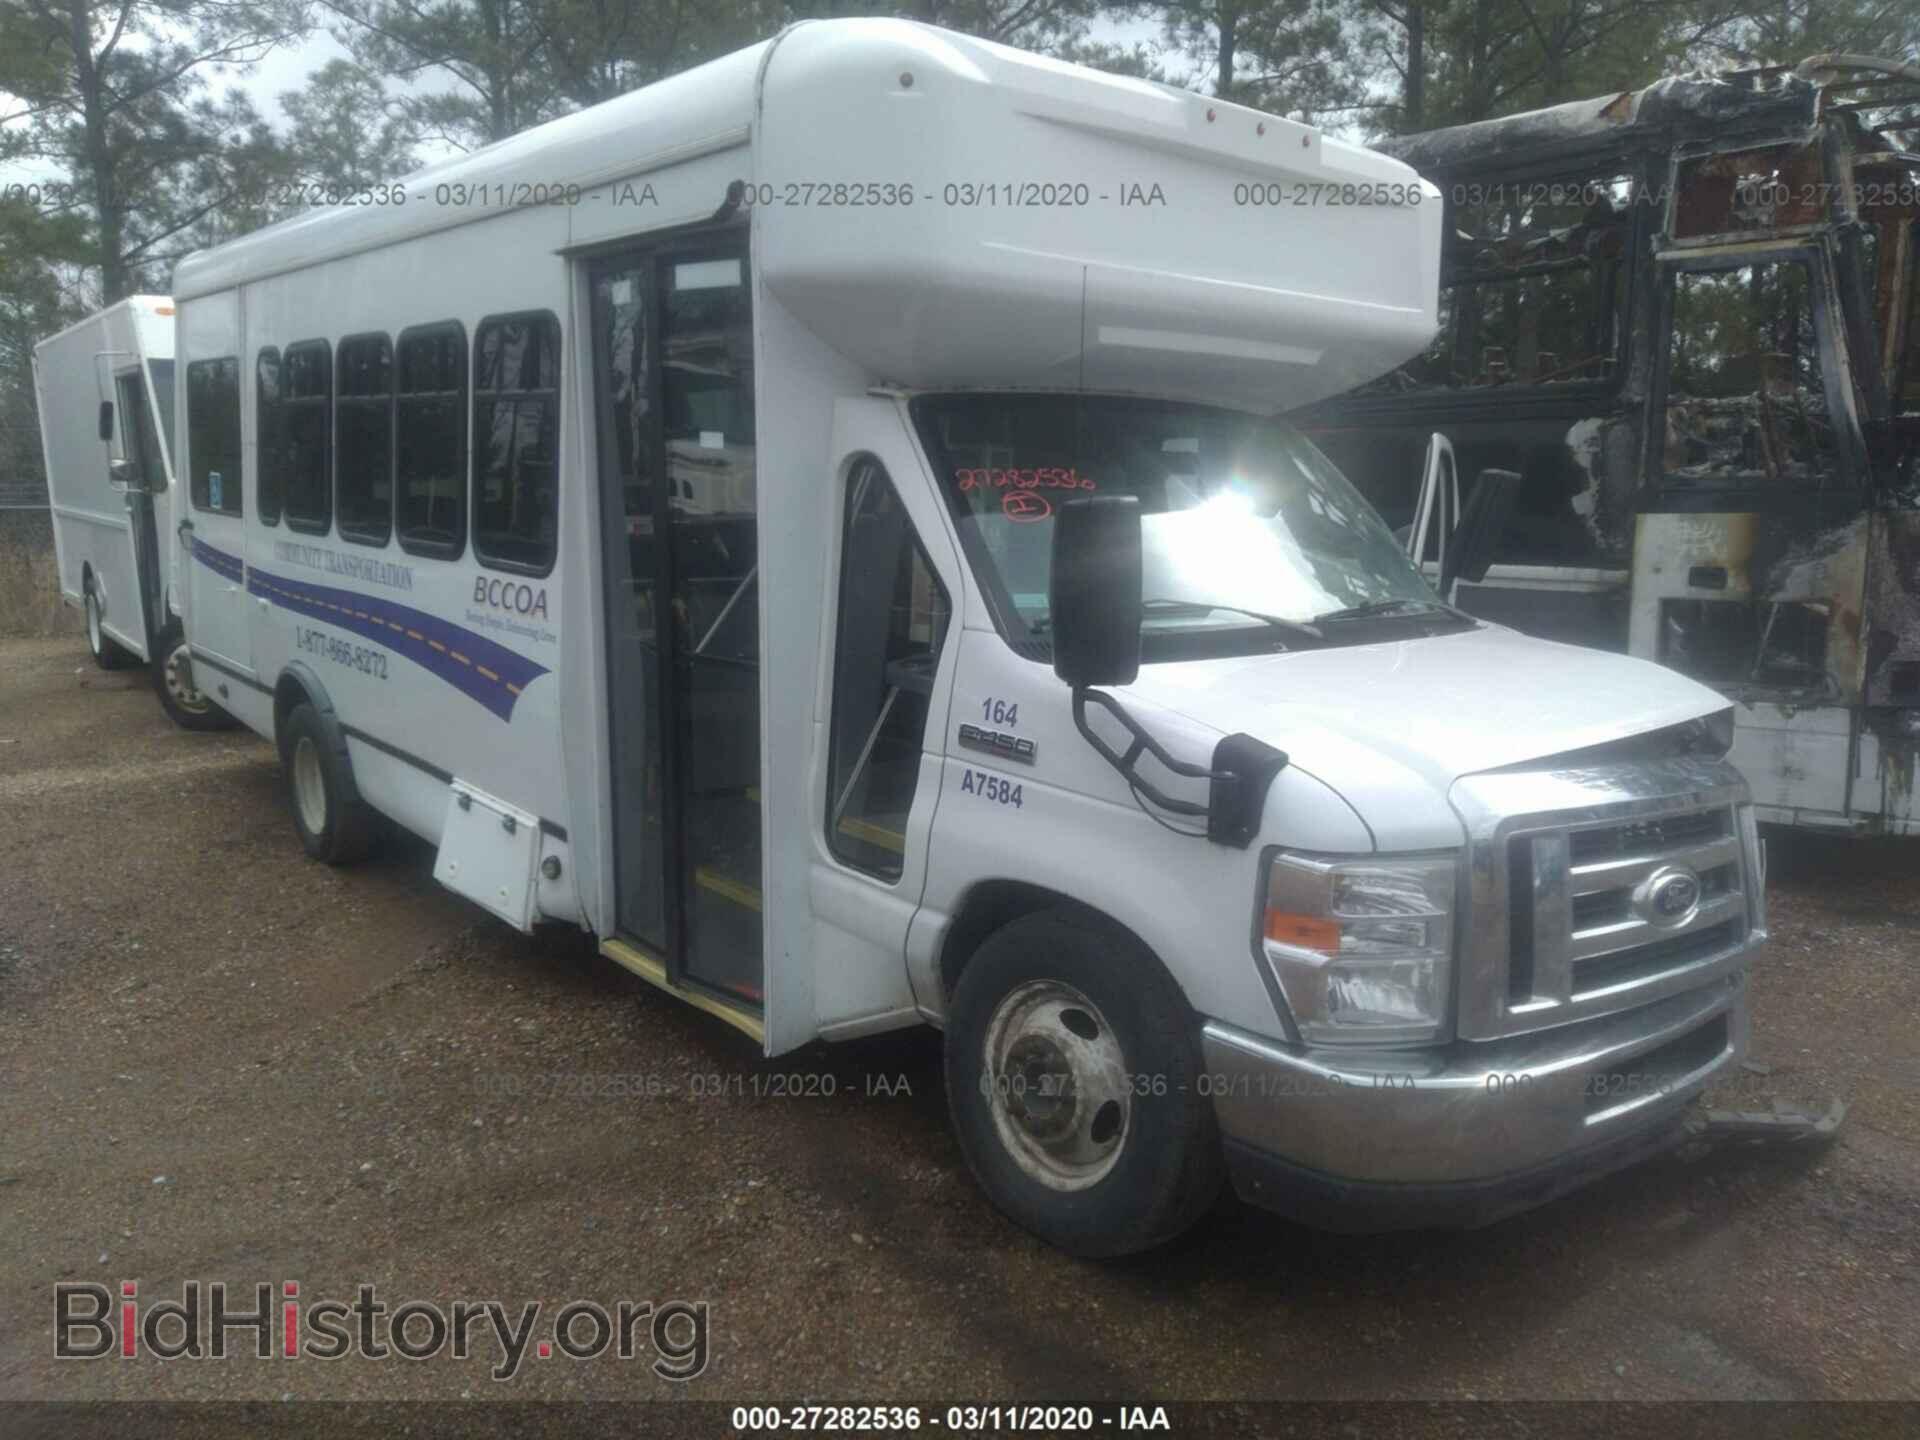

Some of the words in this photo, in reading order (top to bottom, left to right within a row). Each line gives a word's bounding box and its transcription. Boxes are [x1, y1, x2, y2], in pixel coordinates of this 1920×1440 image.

[474, 576, 549, 620] BCCOA
[983, 697, 1018, 728] 164
[961, 769, 1023, 809] A7584
